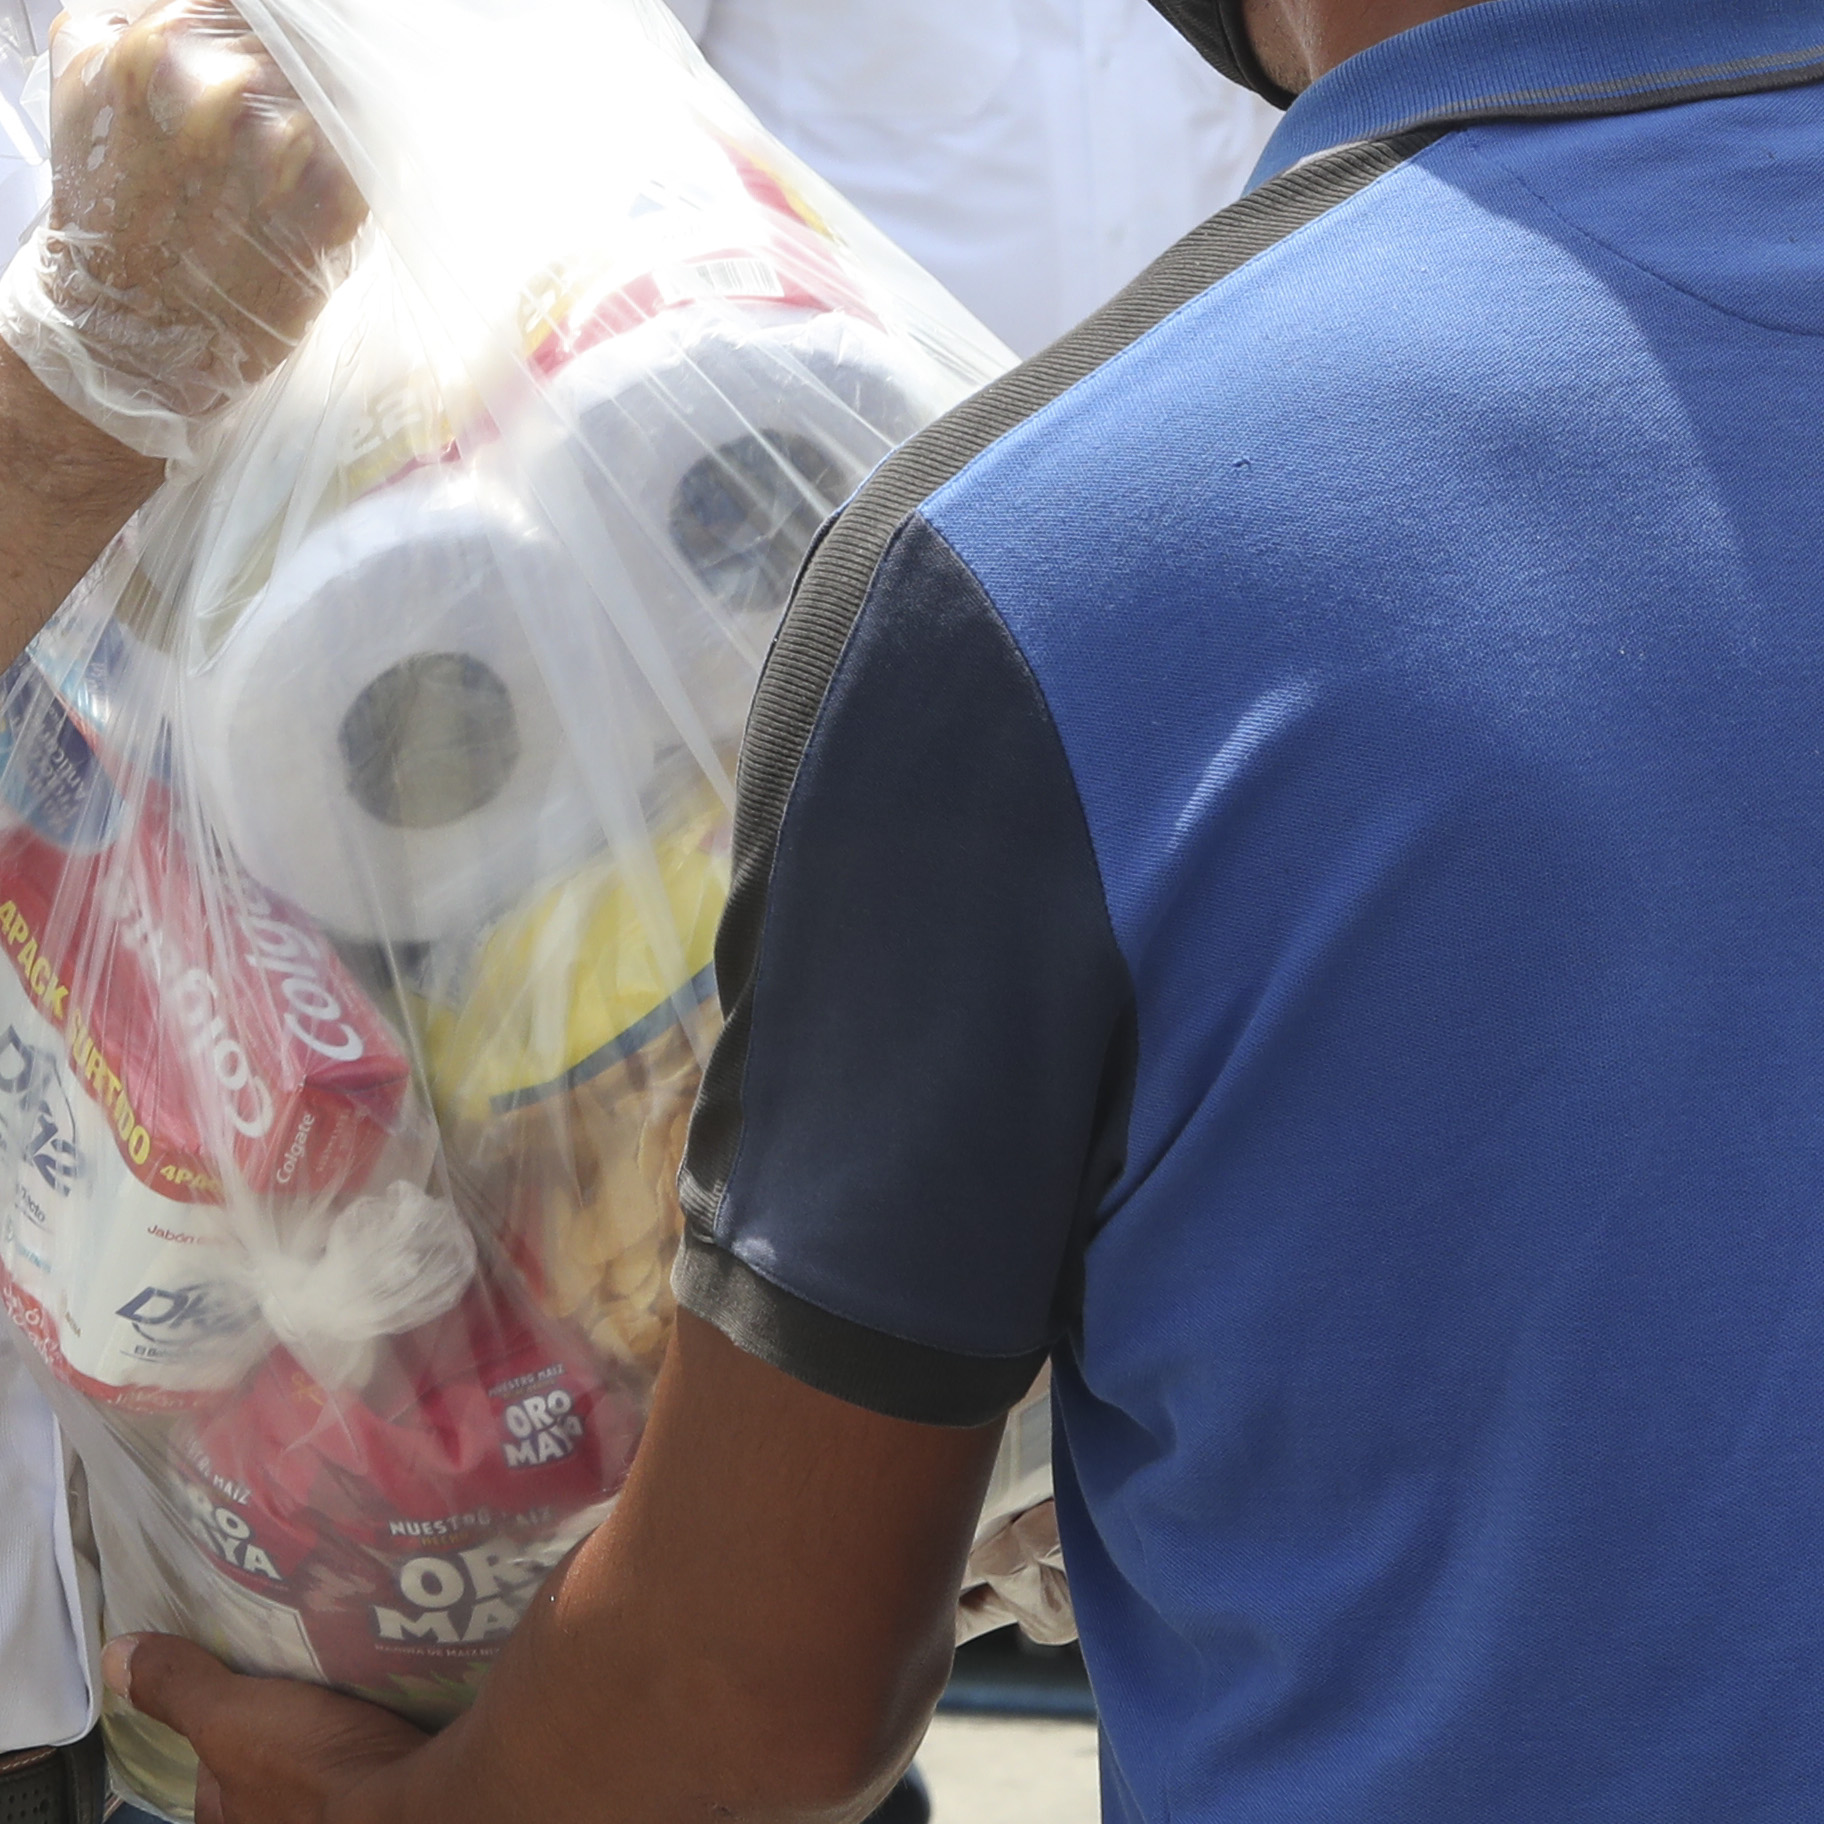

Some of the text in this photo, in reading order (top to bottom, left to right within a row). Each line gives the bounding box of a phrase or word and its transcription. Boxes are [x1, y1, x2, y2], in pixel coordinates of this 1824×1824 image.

[226, 881, 365, 1063] Colg
[72, 1008, 152, 1166] SURTIDO
[275, 1113, 315, 1184] Colgate
[147, 1223, 194, 1245] Jabón
[504, 1388, 574, 1439] ORO
[372, 1598, 522, 1644] MA
